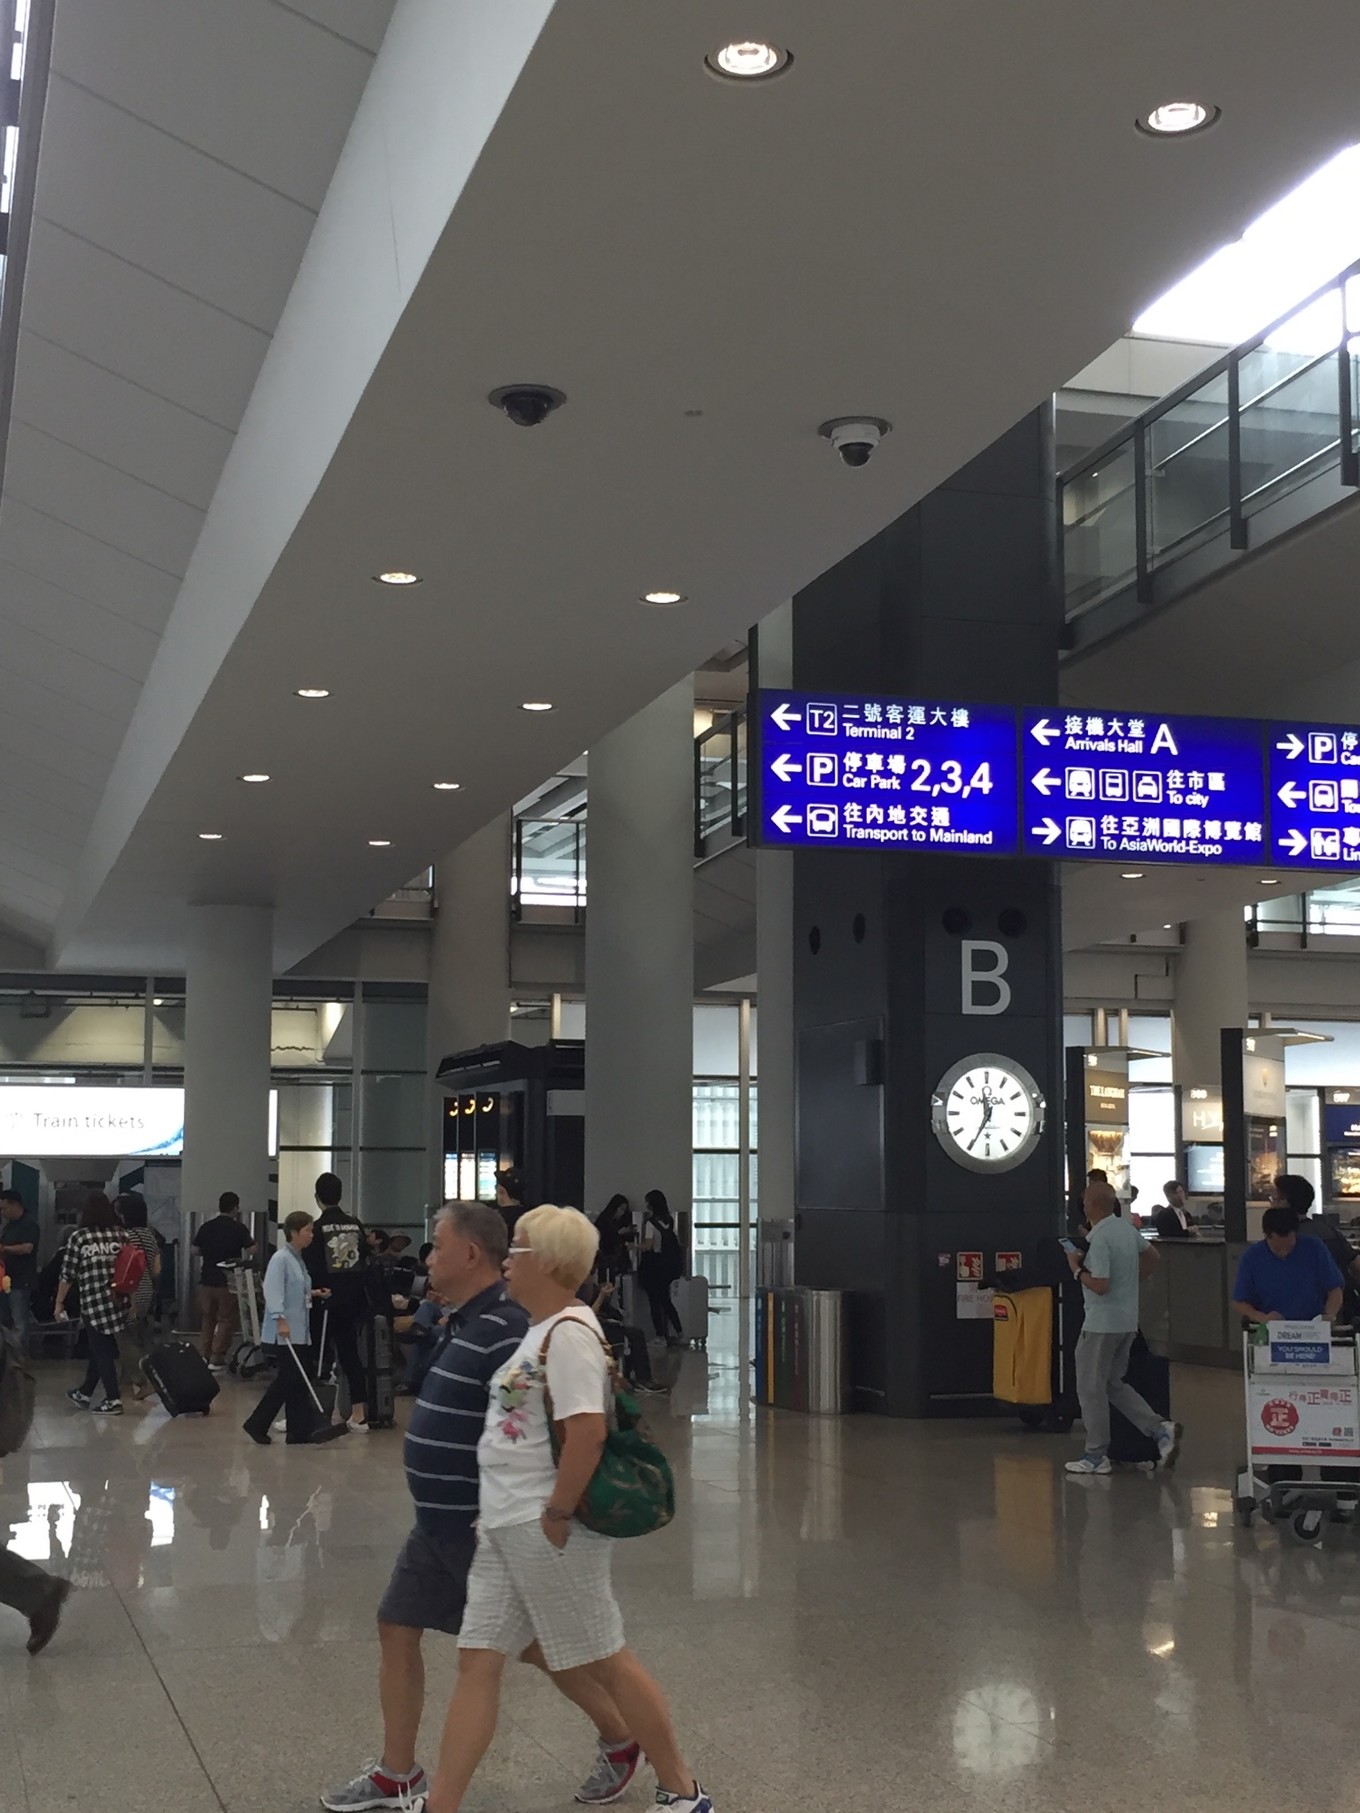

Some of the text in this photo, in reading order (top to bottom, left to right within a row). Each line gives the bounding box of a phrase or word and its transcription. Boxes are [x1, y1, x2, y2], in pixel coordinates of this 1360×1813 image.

[810, 710, 835, 728] T2
[843, 703, 969, 729] 二號客運大樓
[1065, 715, 1145, 738] 接機大堂
[843, 723, 914, 740] Terminal 2
[1151, 724, 1178, 755] A
[1065, 735, 1142, 753] Arrivals Hall
[1314, 736, 1332, 760] P
[813, 758, 833, 782] P
[843, 752, 906, 775] 停車場
[843, 773, 902, 789] Car Park
[911, 759, 993, 798] 2,3,4
[1167, 770, 1225, 791] 往市區
[1166, 790, 1209, 808] To city
[843, 824, 992, 844] Transport to Mainland
[1101, 836, 1222, 856] To AsiaWorld-Expo
[962, 941, 1010, 1014] B
[33, 1112, 79, 1129] Train
[84, 1113, 145, 1129] tickets
